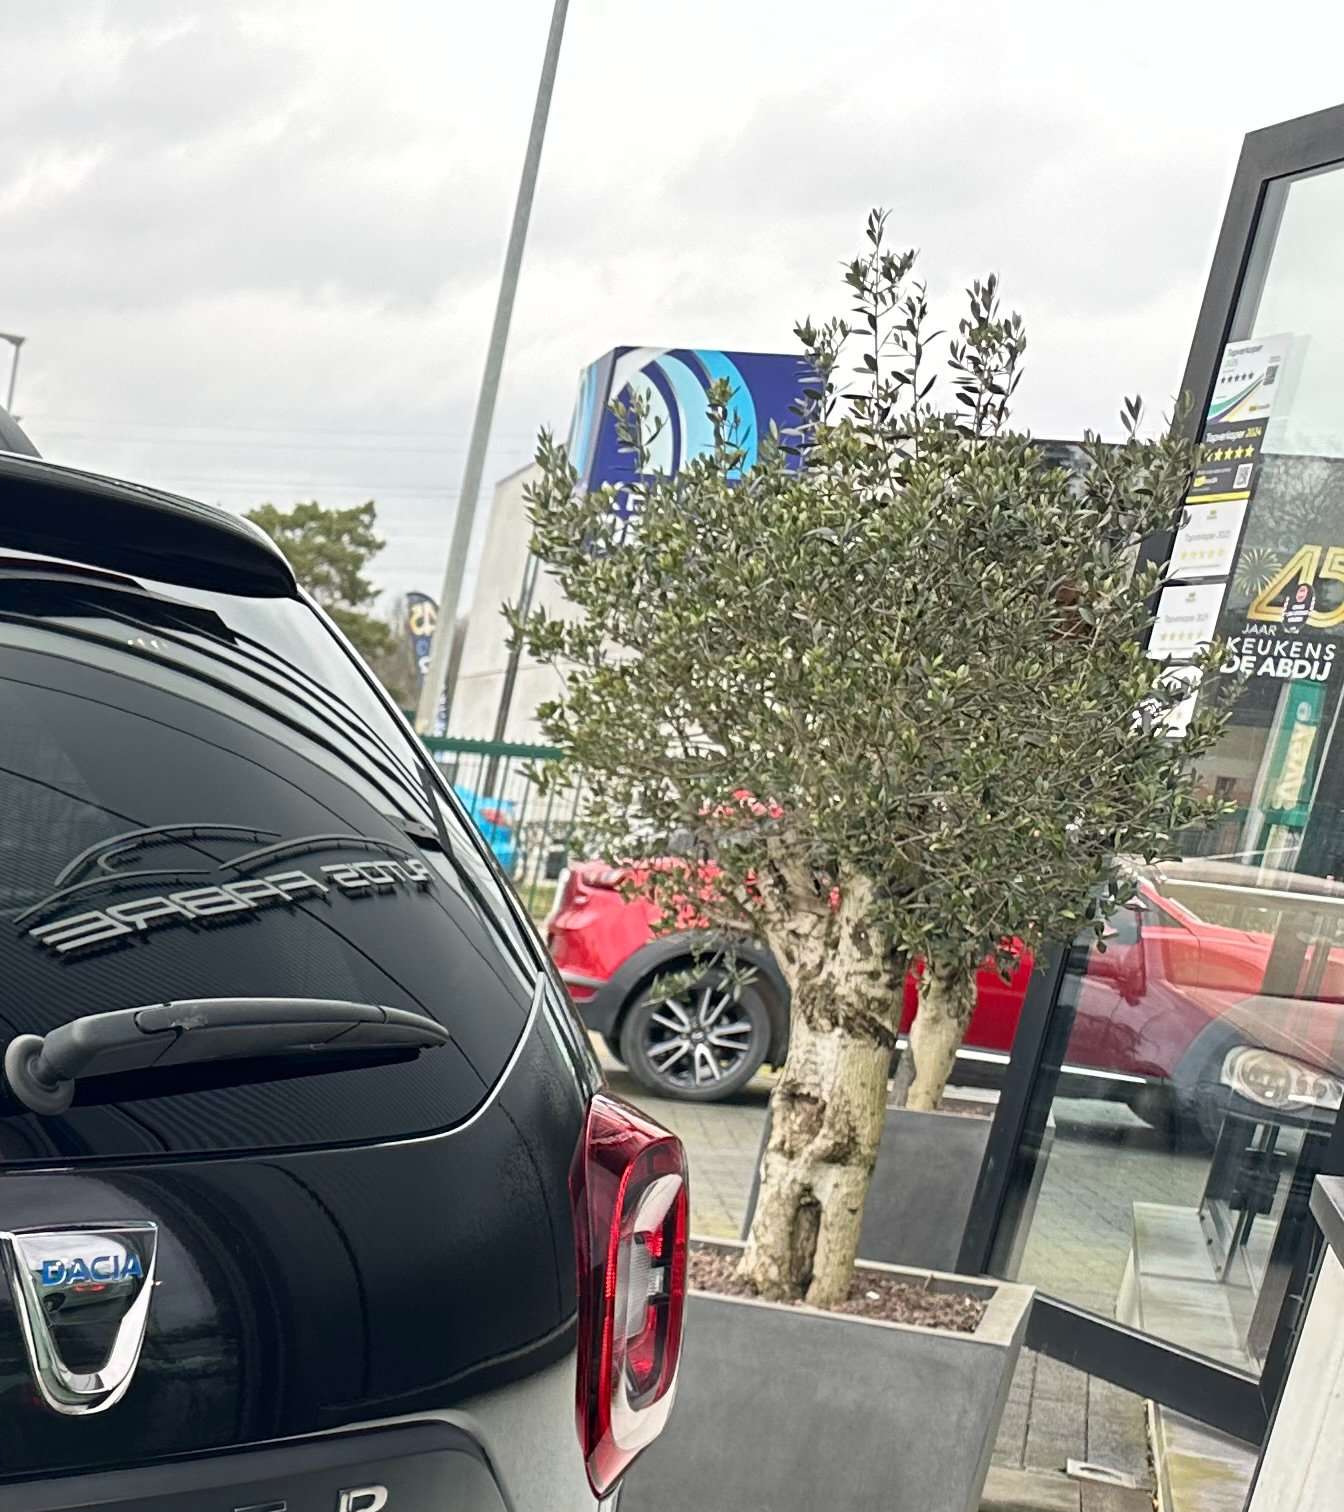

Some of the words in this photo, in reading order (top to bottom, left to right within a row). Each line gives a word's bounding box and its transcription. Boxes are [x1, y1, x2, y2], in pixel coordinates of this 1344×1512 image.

[1241, 623, 1277, 636] JAAR
[1225, 636, 1337, 661] KEUKENS
[1219, 655, 1257, 676] DE
[1257, 656, 1332, 681] ABDIJ
[41, 1253, 145, 1287] DACIA
